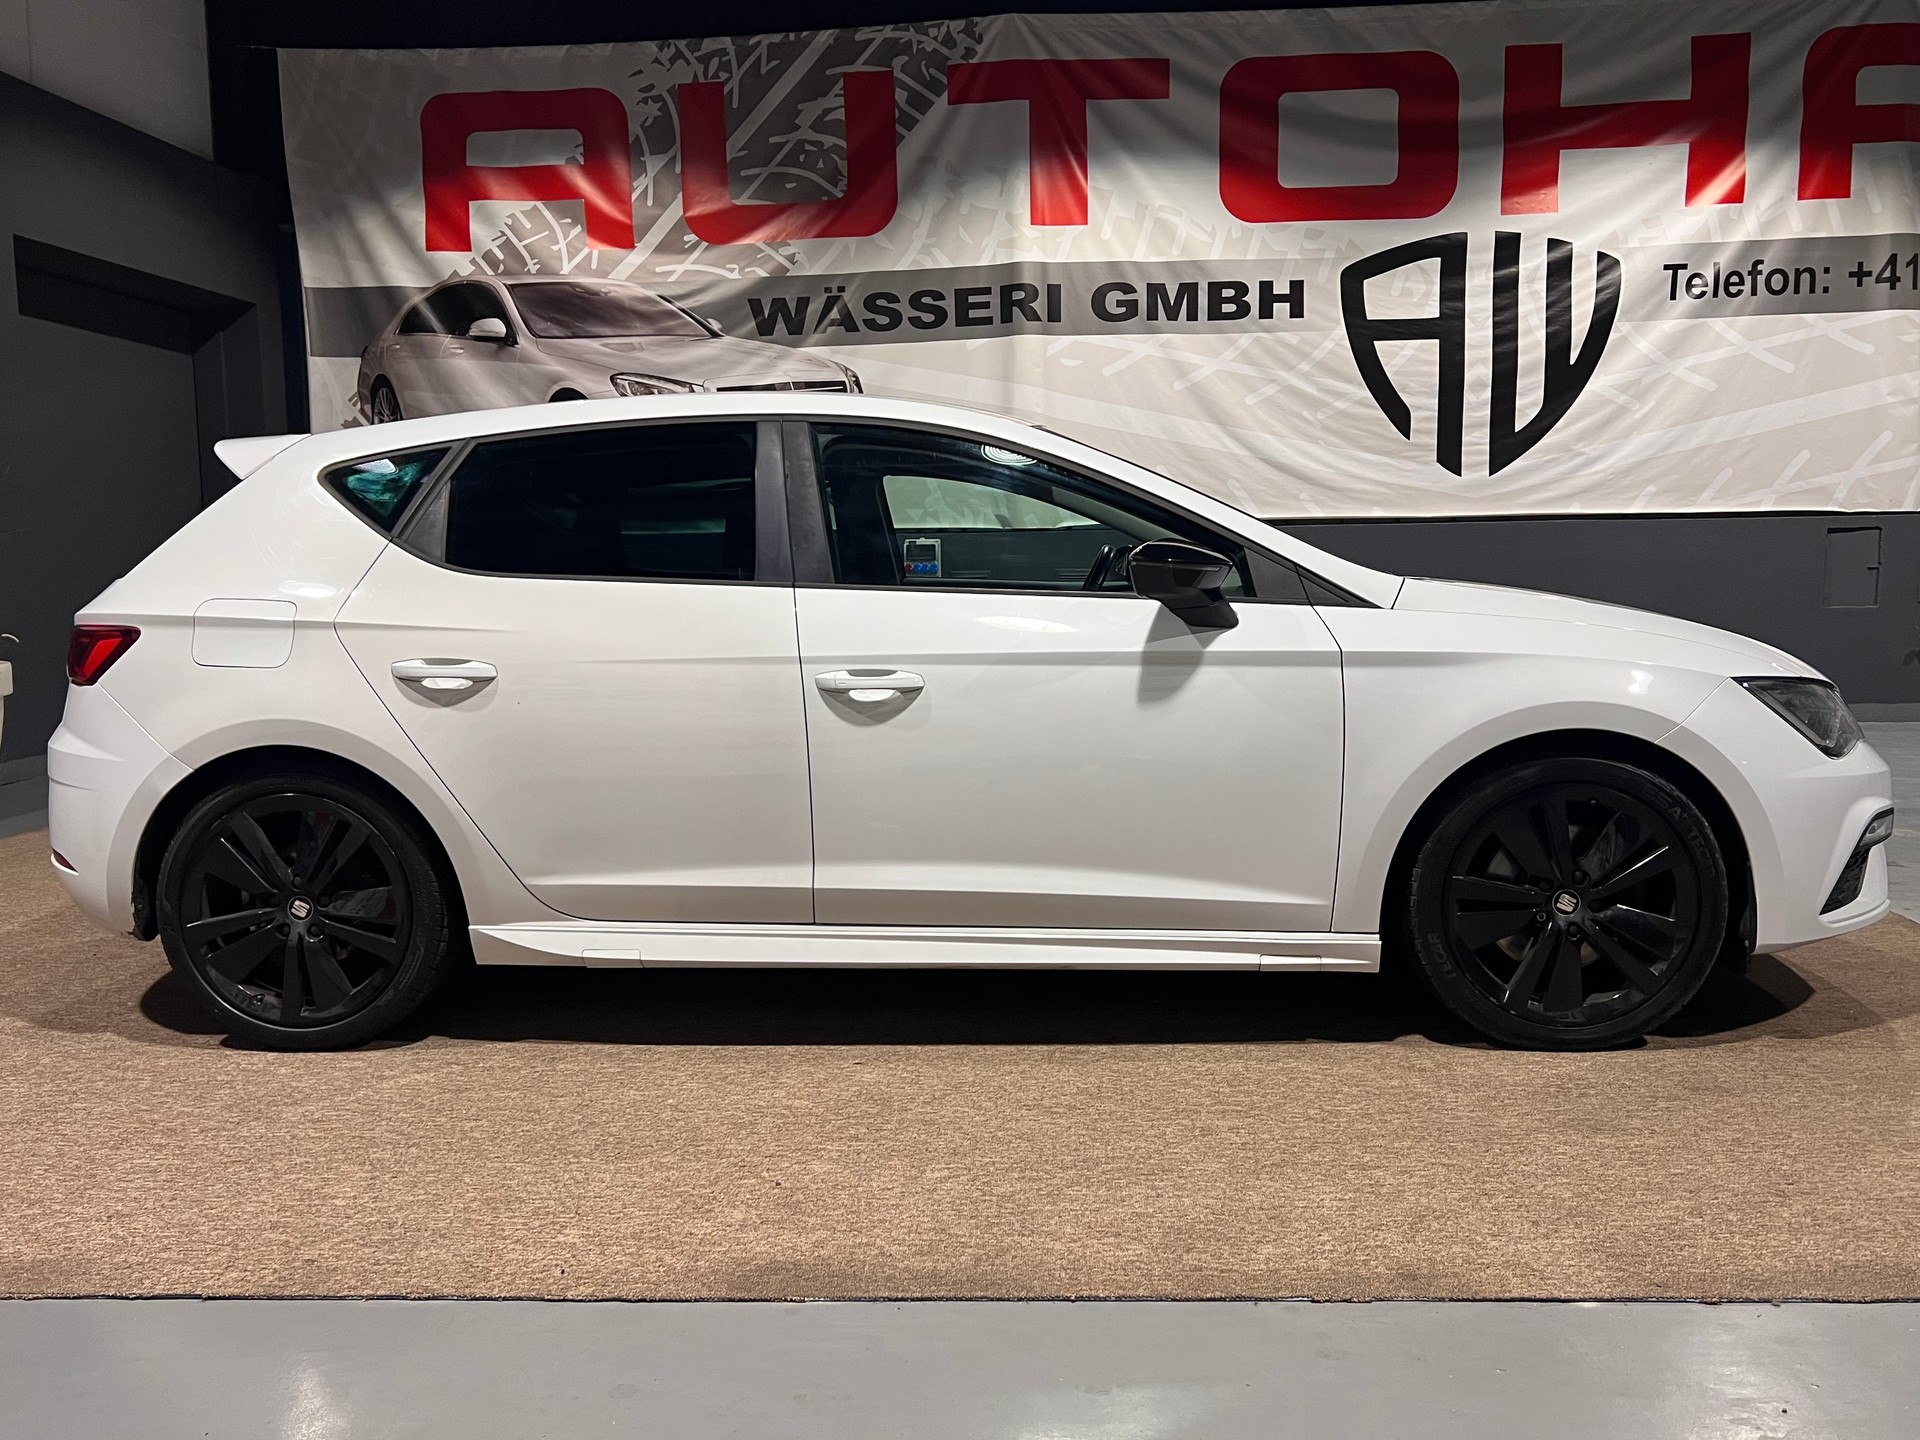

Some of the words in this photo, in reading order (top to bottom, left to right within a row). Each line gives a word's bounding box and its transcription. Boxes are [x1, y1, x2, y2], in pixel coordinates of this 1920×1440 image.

[1662, 258, 1831, 303] Telefon:
[1847, 252, 1919, 291] +41
[747, 282, 1062, 337] WÄSSERI
[1090, 279, 1305, 323] GMBH
